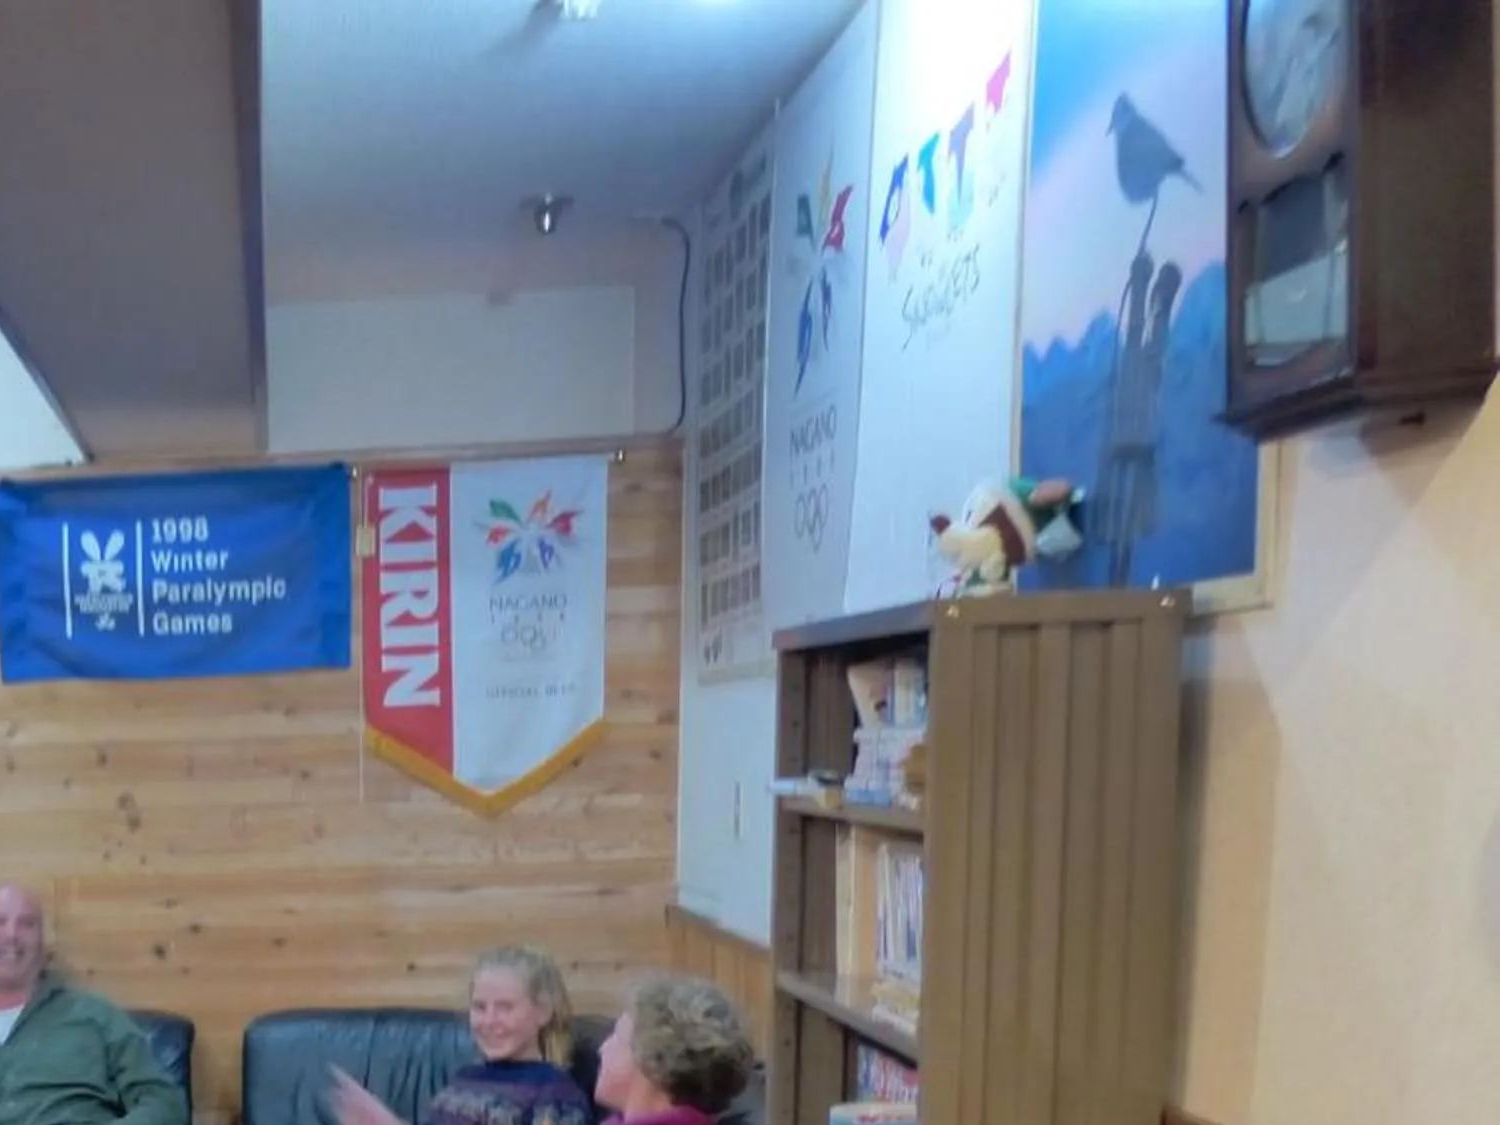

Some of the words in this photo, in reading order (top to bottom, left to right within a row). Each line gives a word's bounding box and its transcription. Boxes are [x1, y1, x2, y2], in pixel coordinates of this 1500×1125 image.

[151, 515, 209, 544] 1998
[151, 549, 229, 573] Winter
[152, 575, 286, 606] Paralympic
[379, 481, 441, 707] KIRIN
[488, 593, 568, 612] NAGANO
[152, 609, 233, 635] Games
